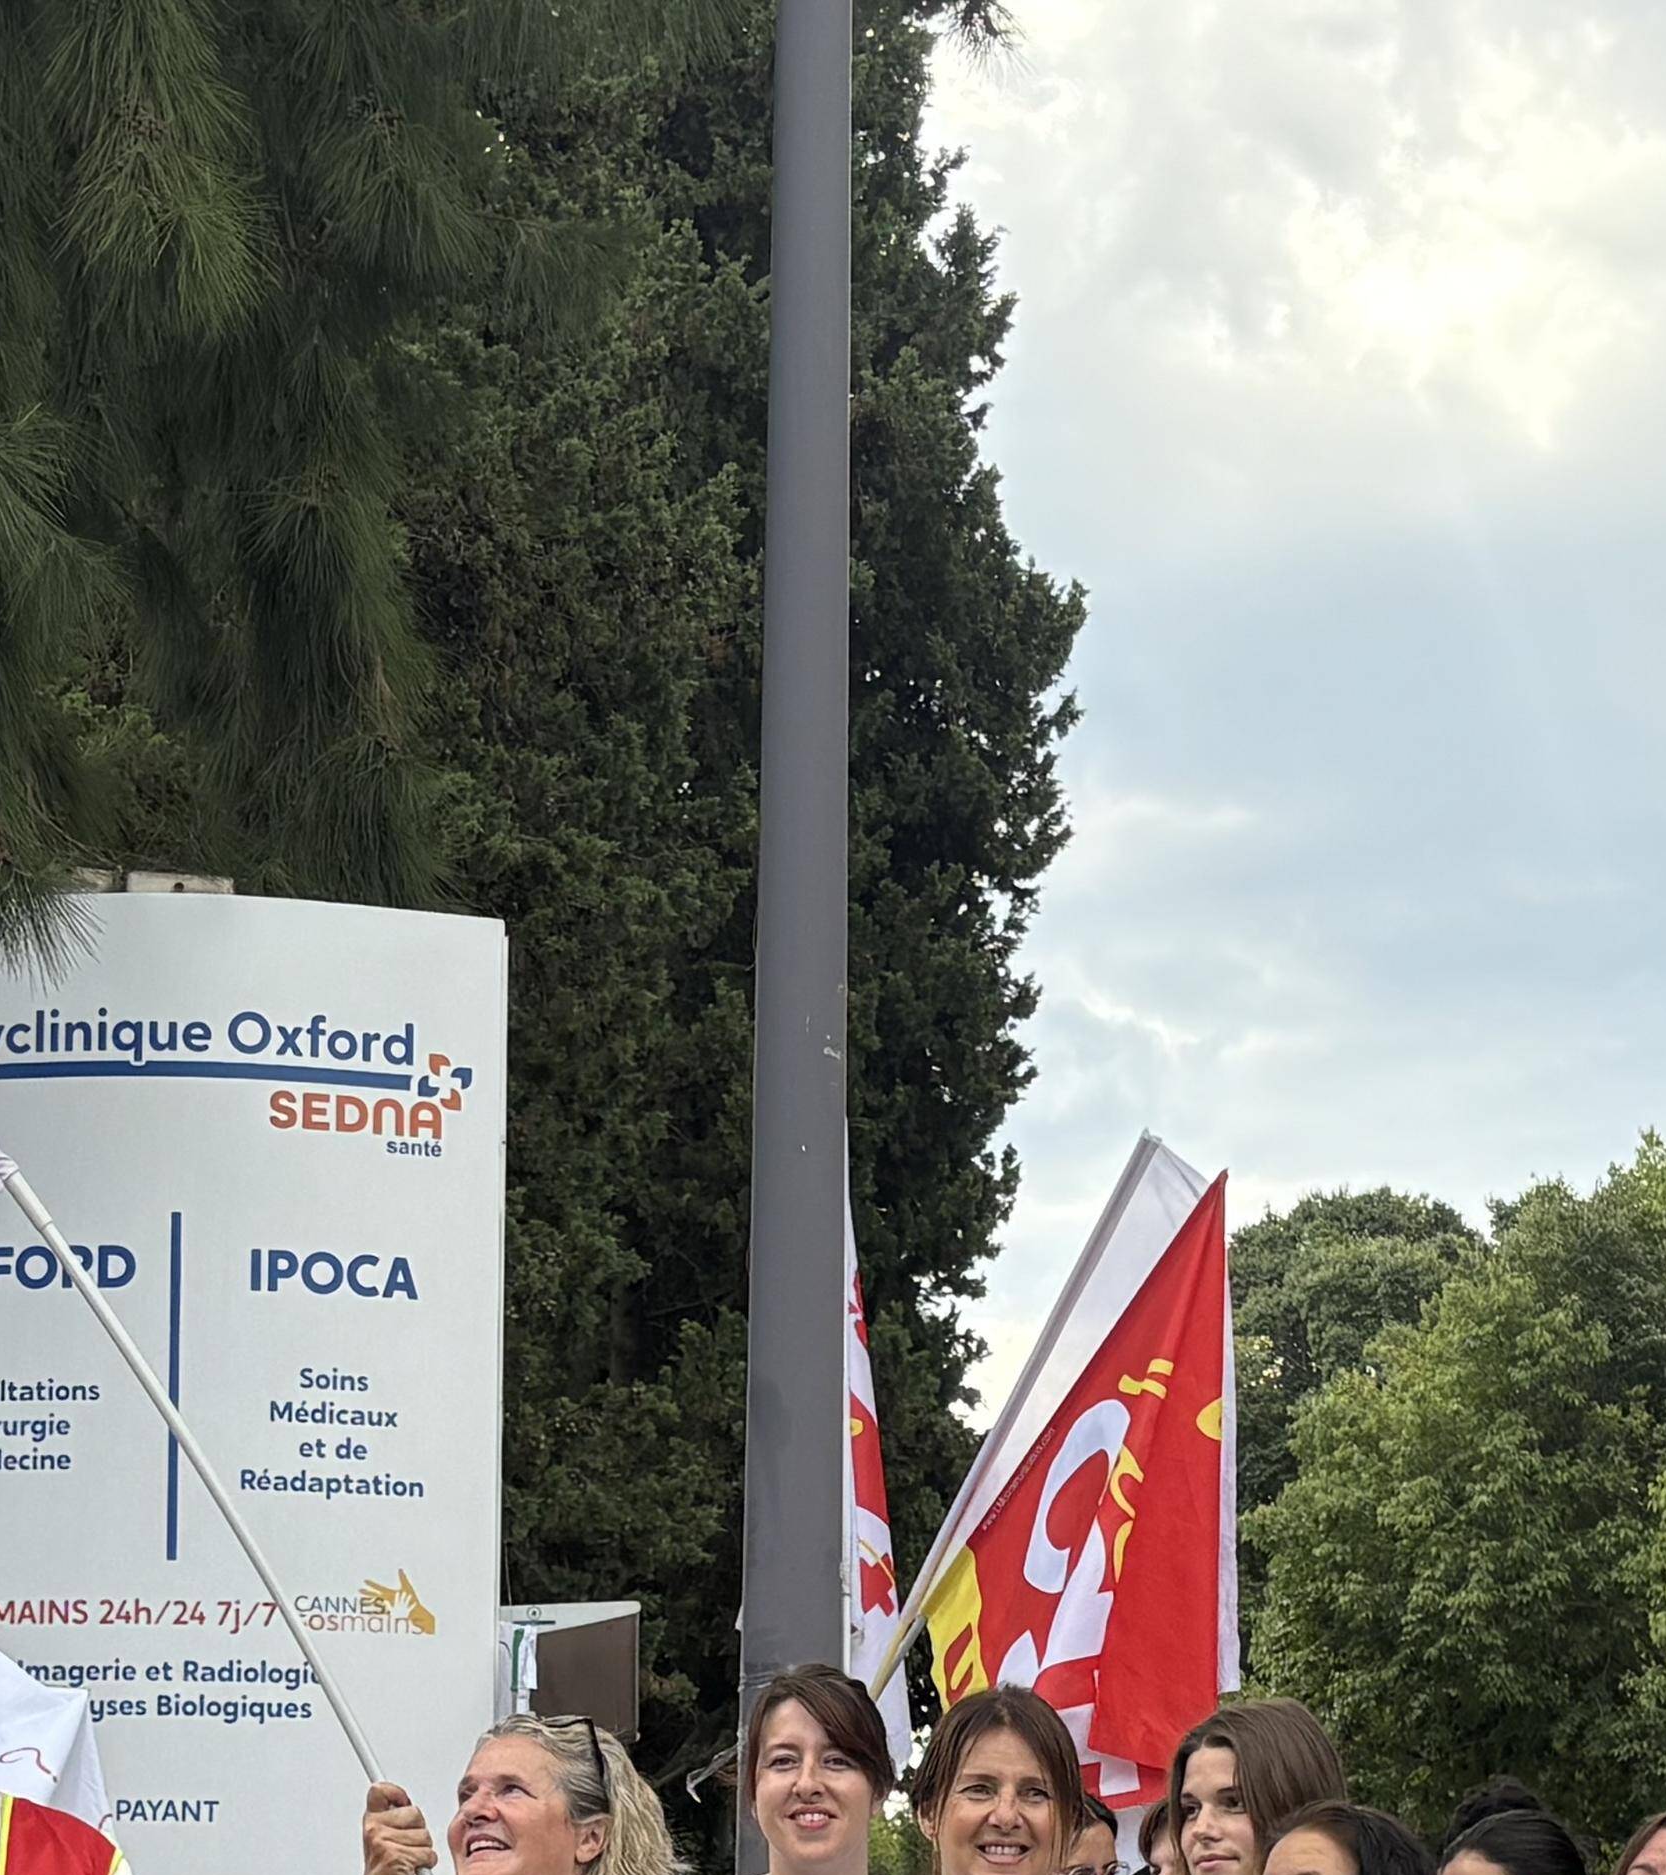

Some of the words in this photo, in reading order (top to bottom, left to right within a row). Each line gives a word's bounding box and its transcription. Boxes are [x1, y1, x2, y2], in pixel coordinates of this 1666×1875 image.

[228, 1010, 415, 1066] Oxford
[269, 1090, 443, 1139] SEDNA
[386, 1138, 442, 1157] santé
[249, 1248, 419, 1301] IPOCA
[299, 1367, 370, 1392] Soins
[269, 1401, 399, 1428] Médicaux
[298, 1439, 325, 1459] et
[335, 1437, 368, 1460] de
[239, 1467, 425, 1499] Réadaptation
[98, 1599, 207, 1626] 24h/24
[217, 1601, 278, 1635] 7j/7
[18, 1658, 137, 1688] magerie
[145, 1663, 174, 1683] et
[88, 1698, 147, 1723] yses
[156, 1693, 312, 1725] Biologiques
[116, 1799, 220, 1823] PAYANT
